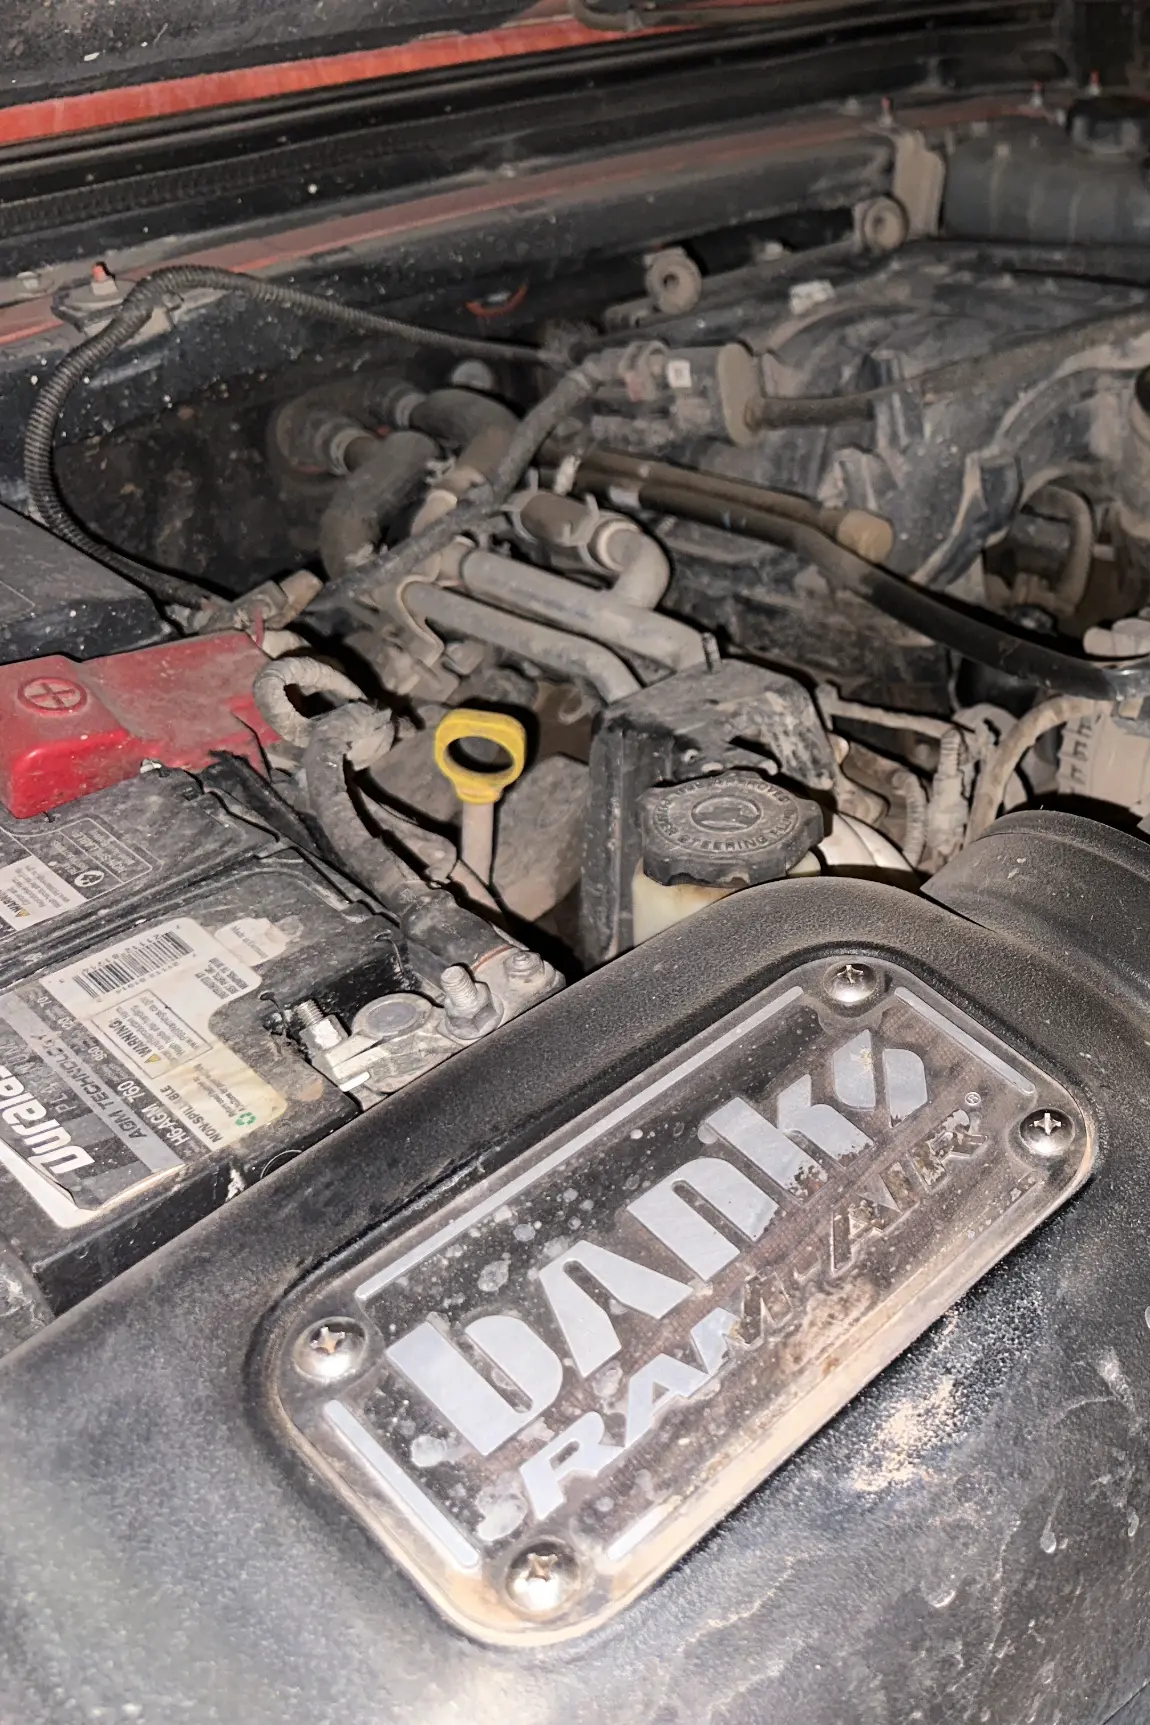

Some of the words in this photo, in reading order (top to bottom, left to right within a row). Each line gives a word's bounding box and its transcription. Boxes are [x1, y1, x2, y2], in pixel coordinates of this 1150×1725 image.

[115, 1079, 147, 1102] 760
[107, 1108, 148, 1141] AGM
[139, 1102, 192, 1145] H6-AGM
